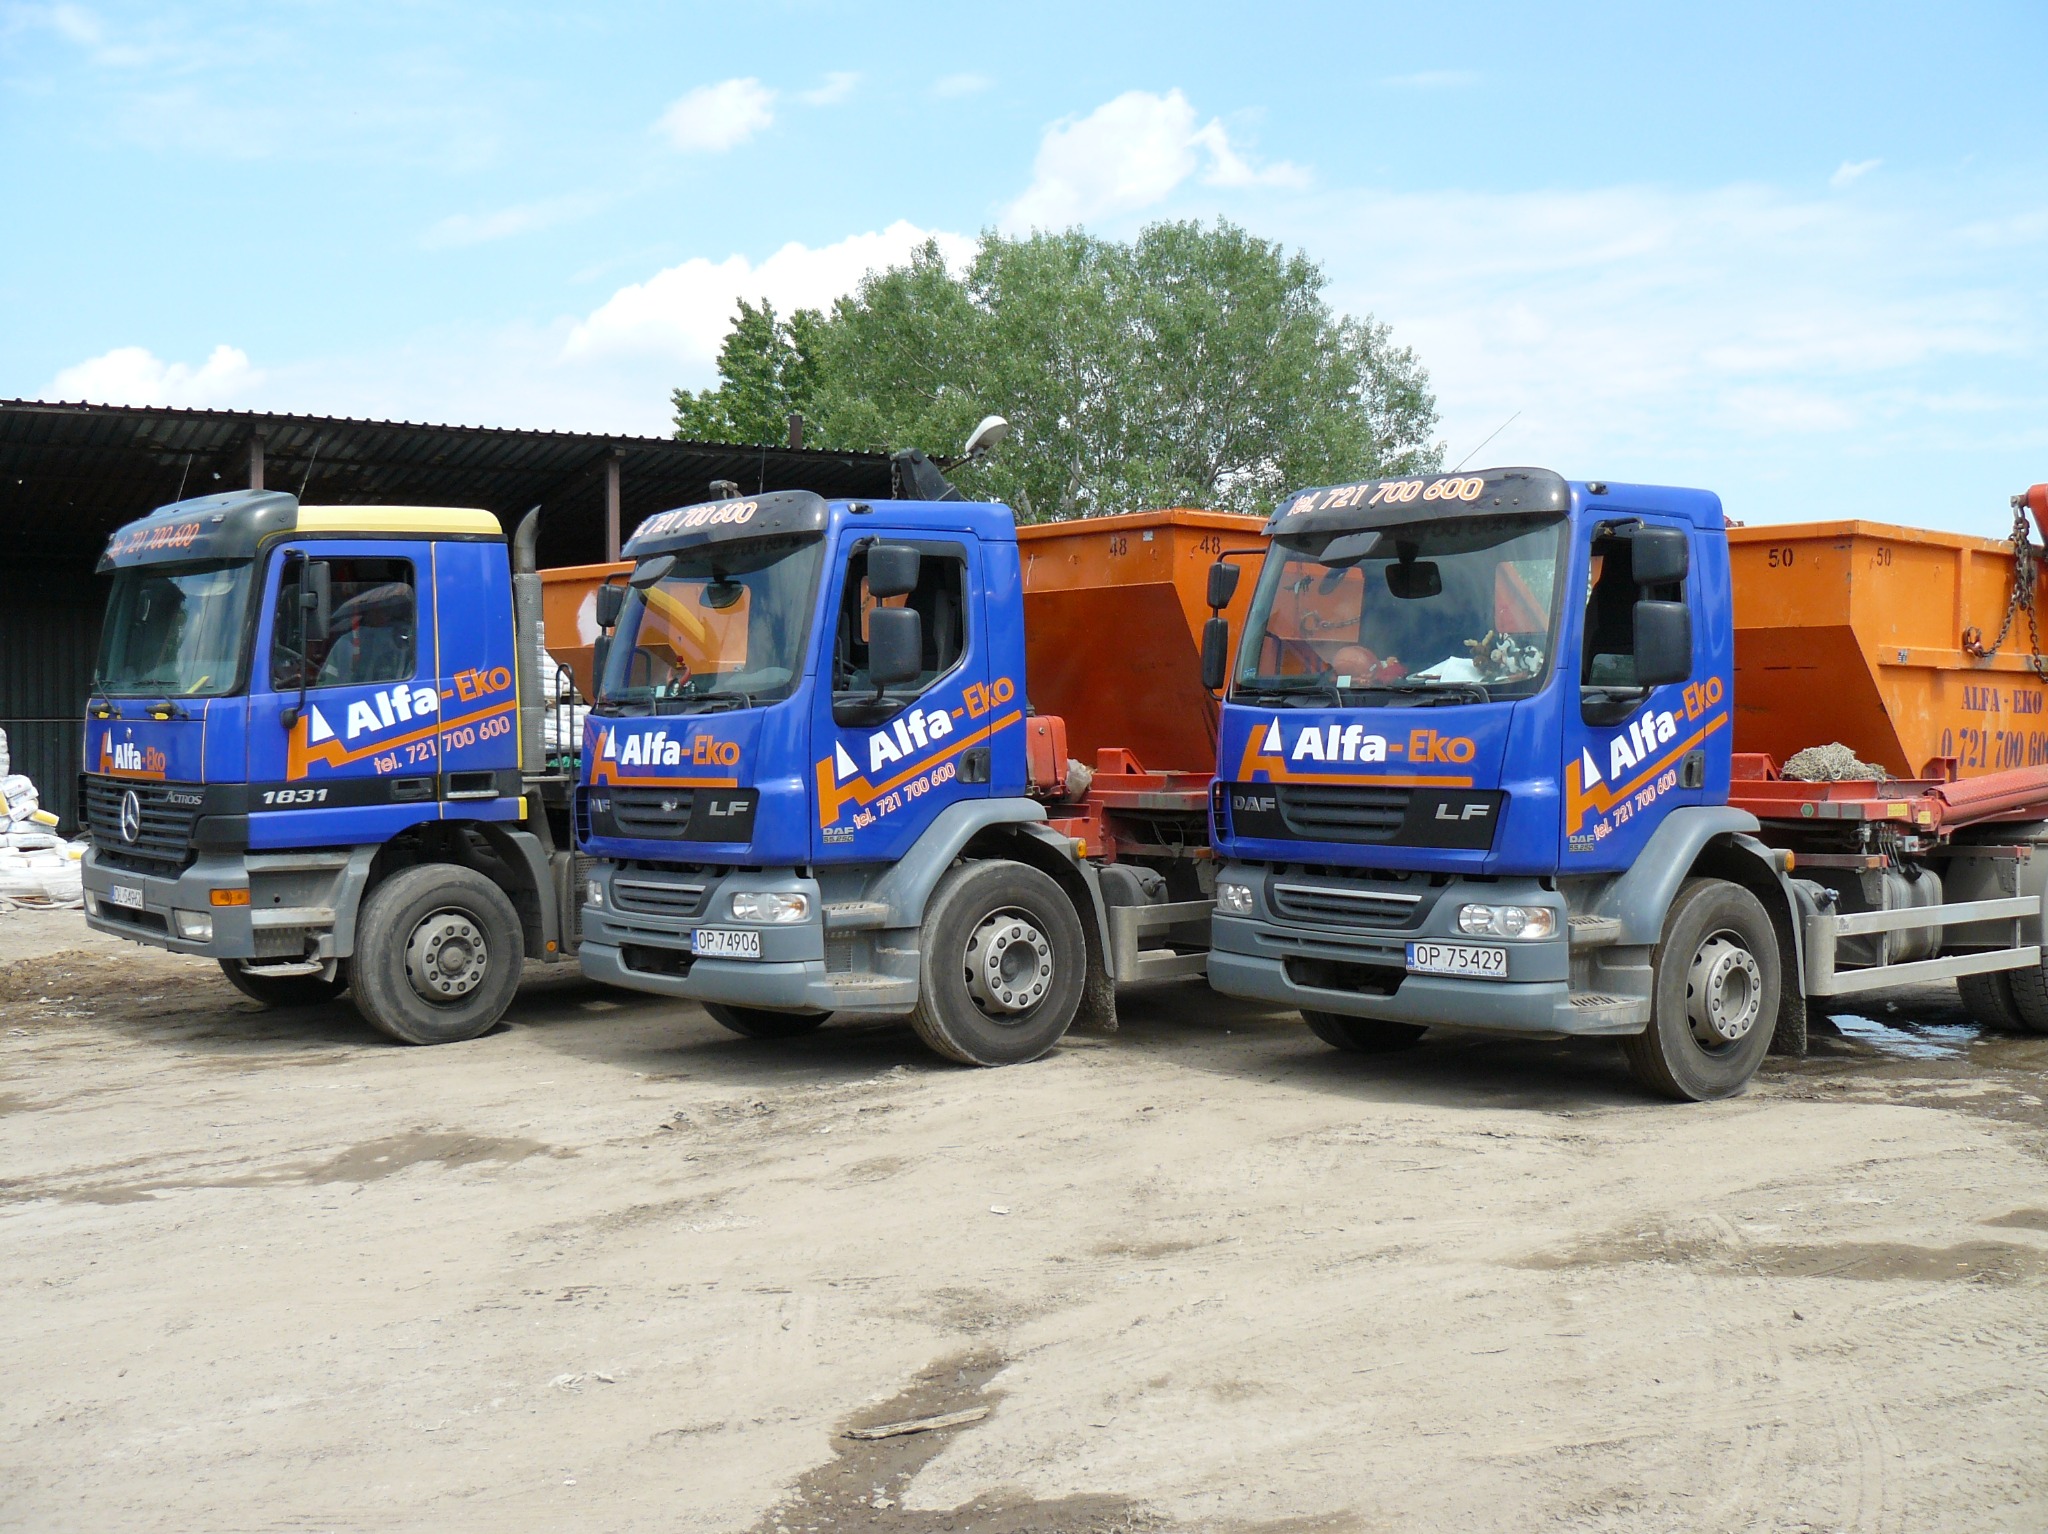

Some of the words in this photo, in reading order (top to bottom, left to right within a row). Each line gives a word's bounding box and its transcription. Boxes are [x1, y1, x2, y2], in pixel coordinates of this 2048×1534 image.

[1319, 485, 1368, 510] 721
[1368, 480, 1424, 504] 700
[1423, 477, 1484, 501] 600
[645, 510, 683, 535] 721
[675, 505, 717, 529] 700
[709, 501, 758, 524] 600
[123, 530, 150, 554] 721
[144, 525, 174, 550] 700
[168, 522, 200, 548] 600
[1109, 538, 1127, 556] 48
[1200, 535, 1221, 555] 48
[1768, 548, 1794, 568] 50
[1876, 547, 1891, 567] 50
[346, 666, 512, 740] Alfa-Eko
[1961, 685, 2001, 712] ALFA
[2013, 690, 2043, 714] EKO
[869, 677, 1015, 773] Alfa-Eko
[1610, 676, 1723, 781] Alfa-Eko
[114, 742, 166, 772] Alfa-Eko
[374, 752, 402, 774] tel.
[405, 738, 437, 764] 721
[442, 726, 476, 752] 700
[479, 715, 511, 741] 600
[621, 731, 741, 766] Alfa-Eko
[1291, 724, 1476, 763] Alfa-Eko
[1959, 727, 1989, 768] 721
[1995, 730, 2025, 769] 700
[262, 788, 328, 805] 1831
[709, 801, 750, 816] LF
[852, 807, 876, 829] tel.
[876, 790, 902, 817] 721
[903, 777, 930, 802] 700
[931, 762, 956, 787] 600
[1233, 795, 1275, 812] DAF
[1593, 817, 1613, 841] tel.
[1613, 800, 1634, 827] 721
[1634, 784, 1656, 812] 700
[1656, 769, 1677, 796] 600
[1435, 803, 1490, 820] LF
[822, 826, 854, 836] DAF
[1568, 834, 1595, 844] DAF
[699, 931, 715, 949] OP
[718, 932, 758, 952] 74906
[1417, 946, 1440, 966] OP
[1447, 948, 1503, 970] 75429
